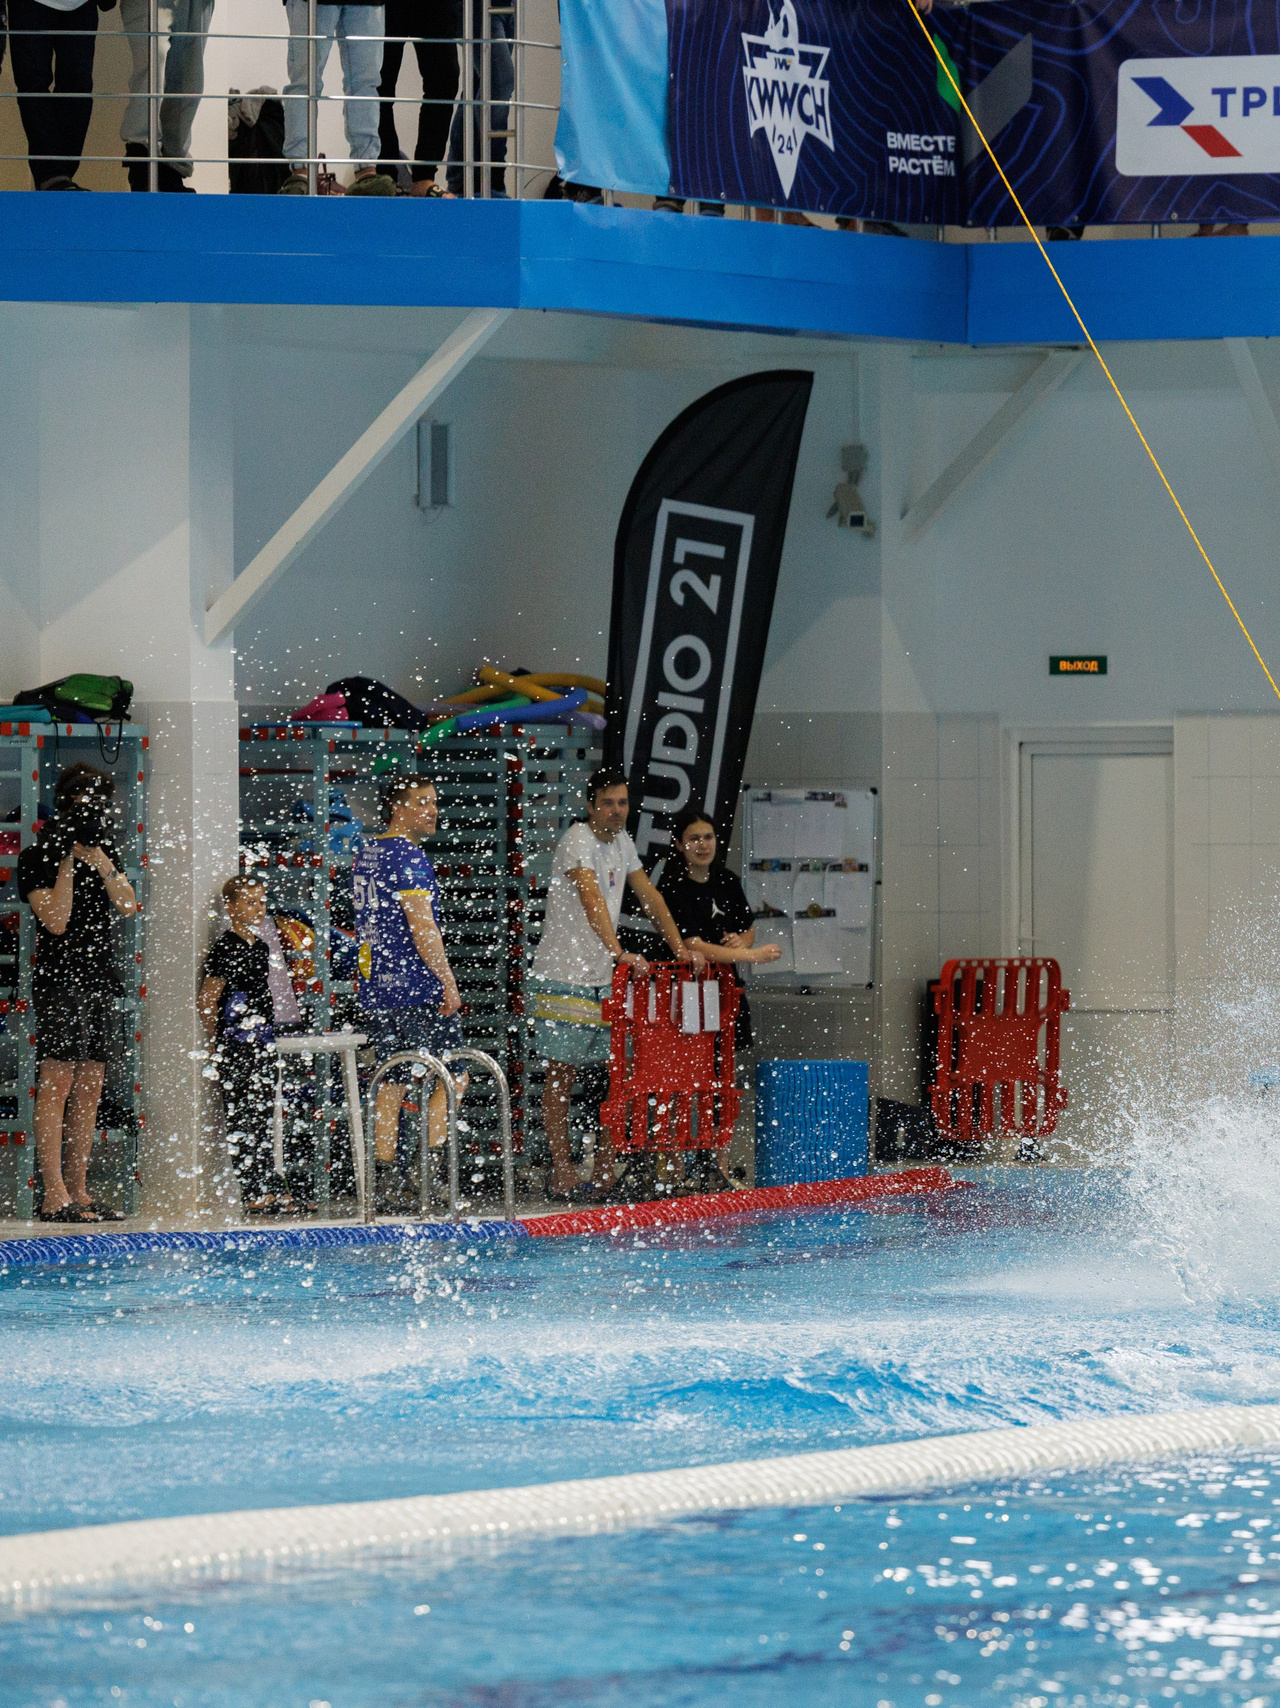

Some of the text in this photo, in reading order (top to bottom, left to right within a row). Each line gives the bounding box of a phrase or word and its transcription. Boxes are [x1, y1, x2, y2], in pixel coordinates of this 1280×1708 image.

[745, 73, 830, 140] KWWCH
[887, 131, 956, 153] ВМЕСТЕ
[888, 155, 956, 177] РАСТЁМ
[1059, 660, 1099, 672] ВЫХОД
[635, 536, 726, 888] TUDIO 21
